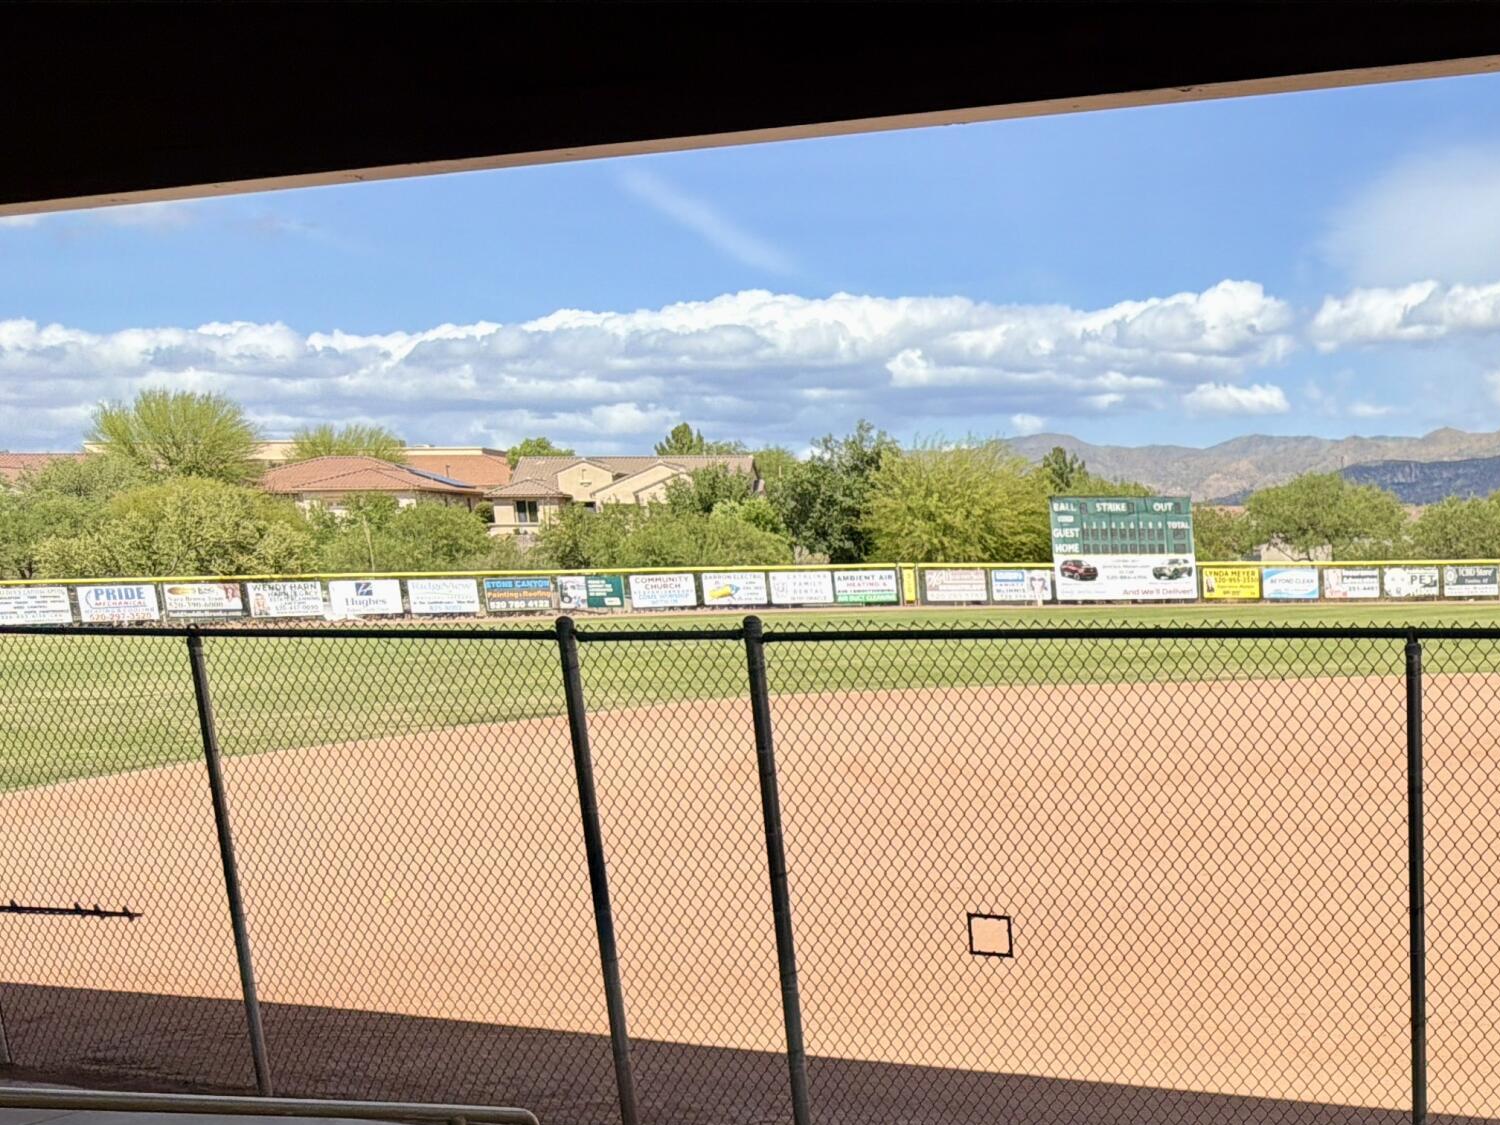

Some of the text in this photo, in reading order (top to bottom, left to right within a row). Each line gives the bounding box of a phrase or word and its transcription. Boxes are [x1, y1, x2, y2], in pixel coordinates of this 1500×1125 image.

[1095, 502, 1127, 513] STRIKE
[1152, 502, 1174, 512] OUT
[1167, 521, 1190, 529] TOTAL
[1053, 528, 1080, 538] GUEST
[1054, 543, 1080, 553] HOME
[634, 576, 689, 584] COMMUNITY
[1410, 575, 1435, 585] PET
[252, 583, 287, 592] WENDY
[644, 583, 681, 591] CHURCH
[94, 587, 145, 601] PRIDE
[345, 598, 388, 608] Hughes
